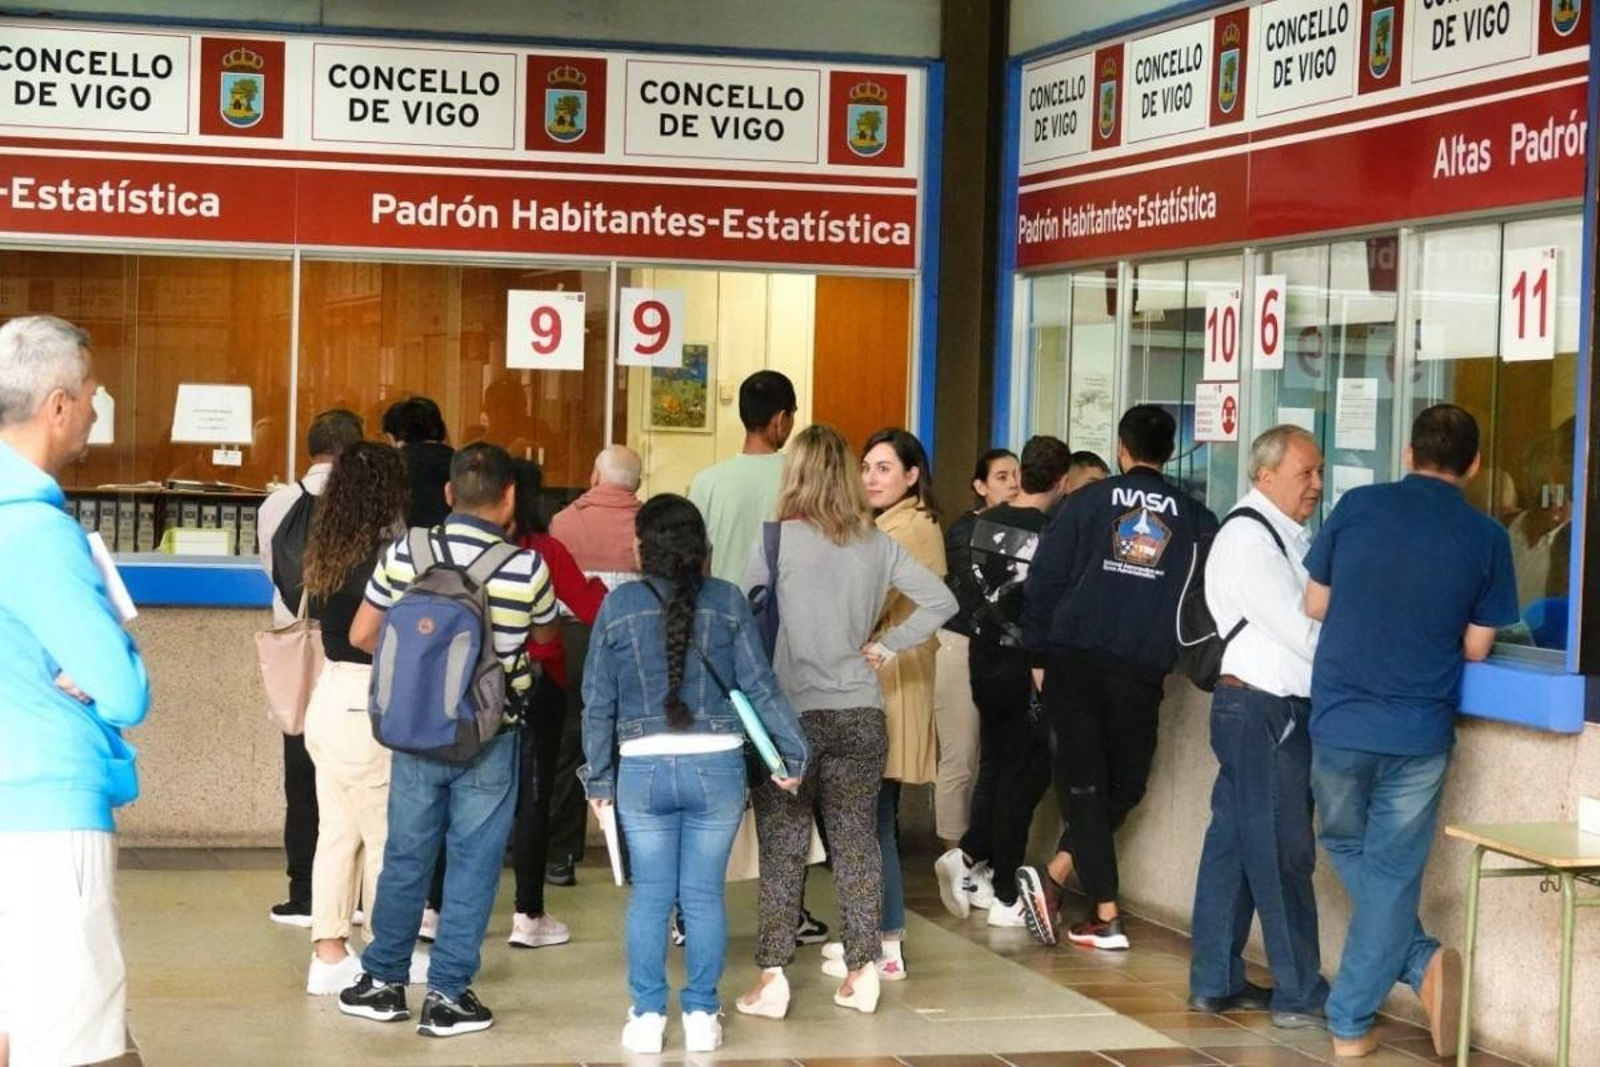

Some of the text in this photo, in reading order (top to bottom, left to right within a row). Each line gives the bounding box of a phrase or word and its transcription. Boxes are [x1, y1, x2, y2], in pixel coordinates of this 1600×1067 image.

[1266, 2, 1348, 51] CONCELLO
[1433, 1, 1509, 50] DE VIGO
[0, 46, 172, 79] CONCELLO
[329, 64, 499, 97] CONCELLO
[1135, 42, 1203, 85] CONCELLO
[1274, 46, 1336, 88] DE VIGO
[15, 81, 150, 111] DE VIGO
[350, 98, 479, 127] DE VIGO
[640, 80, 804, 112] CONCELLO
[1029, 73, 1086, 112] CONCELLO
[1142, 83, 1191, 118] DE VIGO
[660, 113, 784, 141] DE VIGO
[1035, 110, 1076, 142] DE VIGO
[1434, 135, 1490, 178] Altas
[373, 193, 911, 246] Padrón Habitantes-Estatística
[1019, 185, 1216, 243] Padrón Habitantes-Estatística
[1260, 288, 1280, 357] 6
[1512, 268, 1549, 338] 11
[530, 304, 562, 356] 9
[633, 299, 671, 356] 9
[1208, 304, 1235, 363] 10
[1112, 488, 1178, 516] NASA
